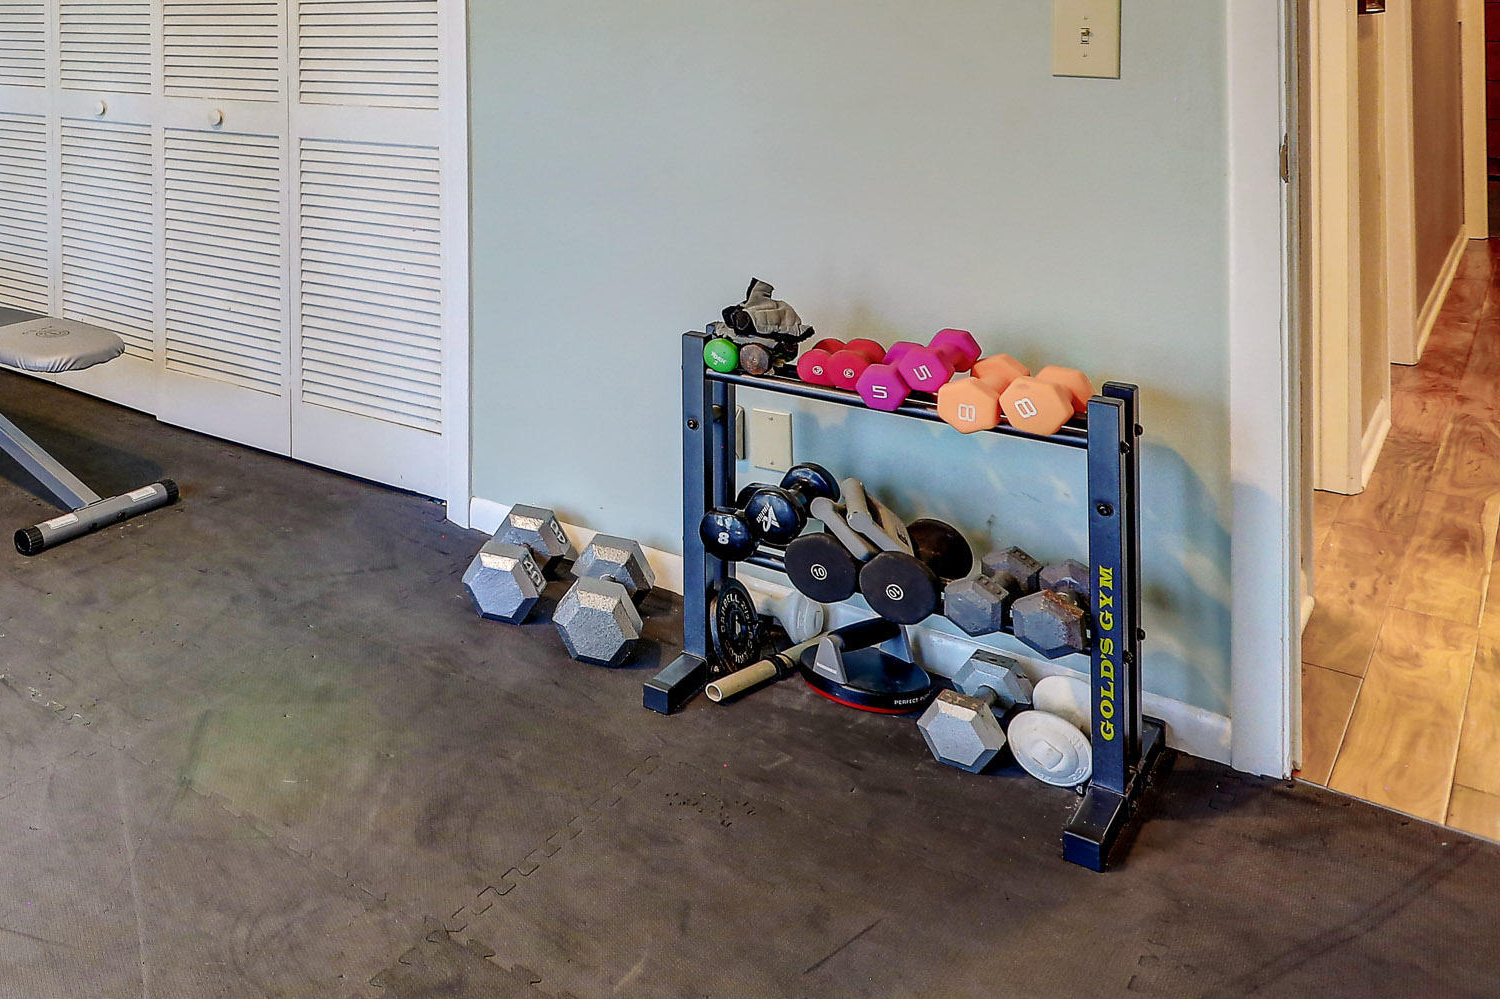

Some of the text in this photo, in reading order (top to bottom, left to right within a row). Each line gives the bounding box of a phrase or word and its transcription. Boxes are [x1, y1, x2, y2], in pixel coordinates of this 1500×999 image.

[913, 364, 932, 381] 5
[872, 385, 888, 399] 5
[957, 403, 976, 422] 8
[1014, 397, 1038, 419] 8
[717, 531, 730, 545] 8
[812, 565, 826, 579] 10
[887, 585, 902, 599] 10
[1099, 565, 1115, 741] GOLD'S GYM
